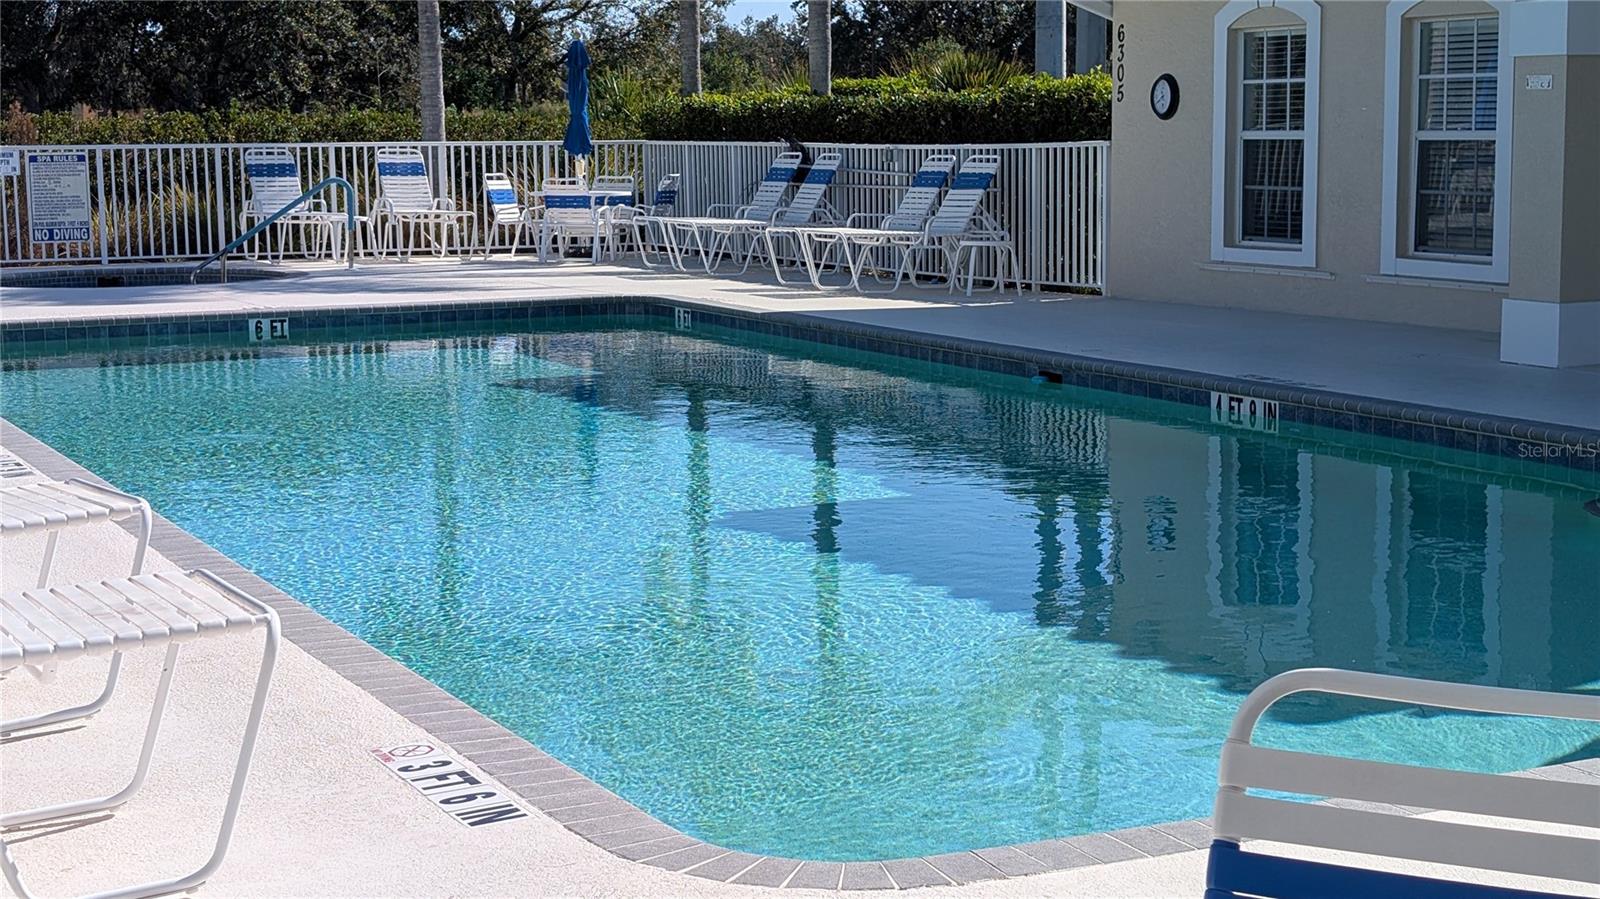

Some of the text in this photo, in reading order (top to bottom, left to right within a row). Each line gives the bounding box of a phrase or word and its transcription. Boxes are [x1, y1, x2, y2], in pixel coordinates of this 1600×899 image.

[1117, 23, 1125, 102] 6305
[34, 228, 88, 240] NO DIVING
[397, 760, 529, 827] 3 FT 6 IN
